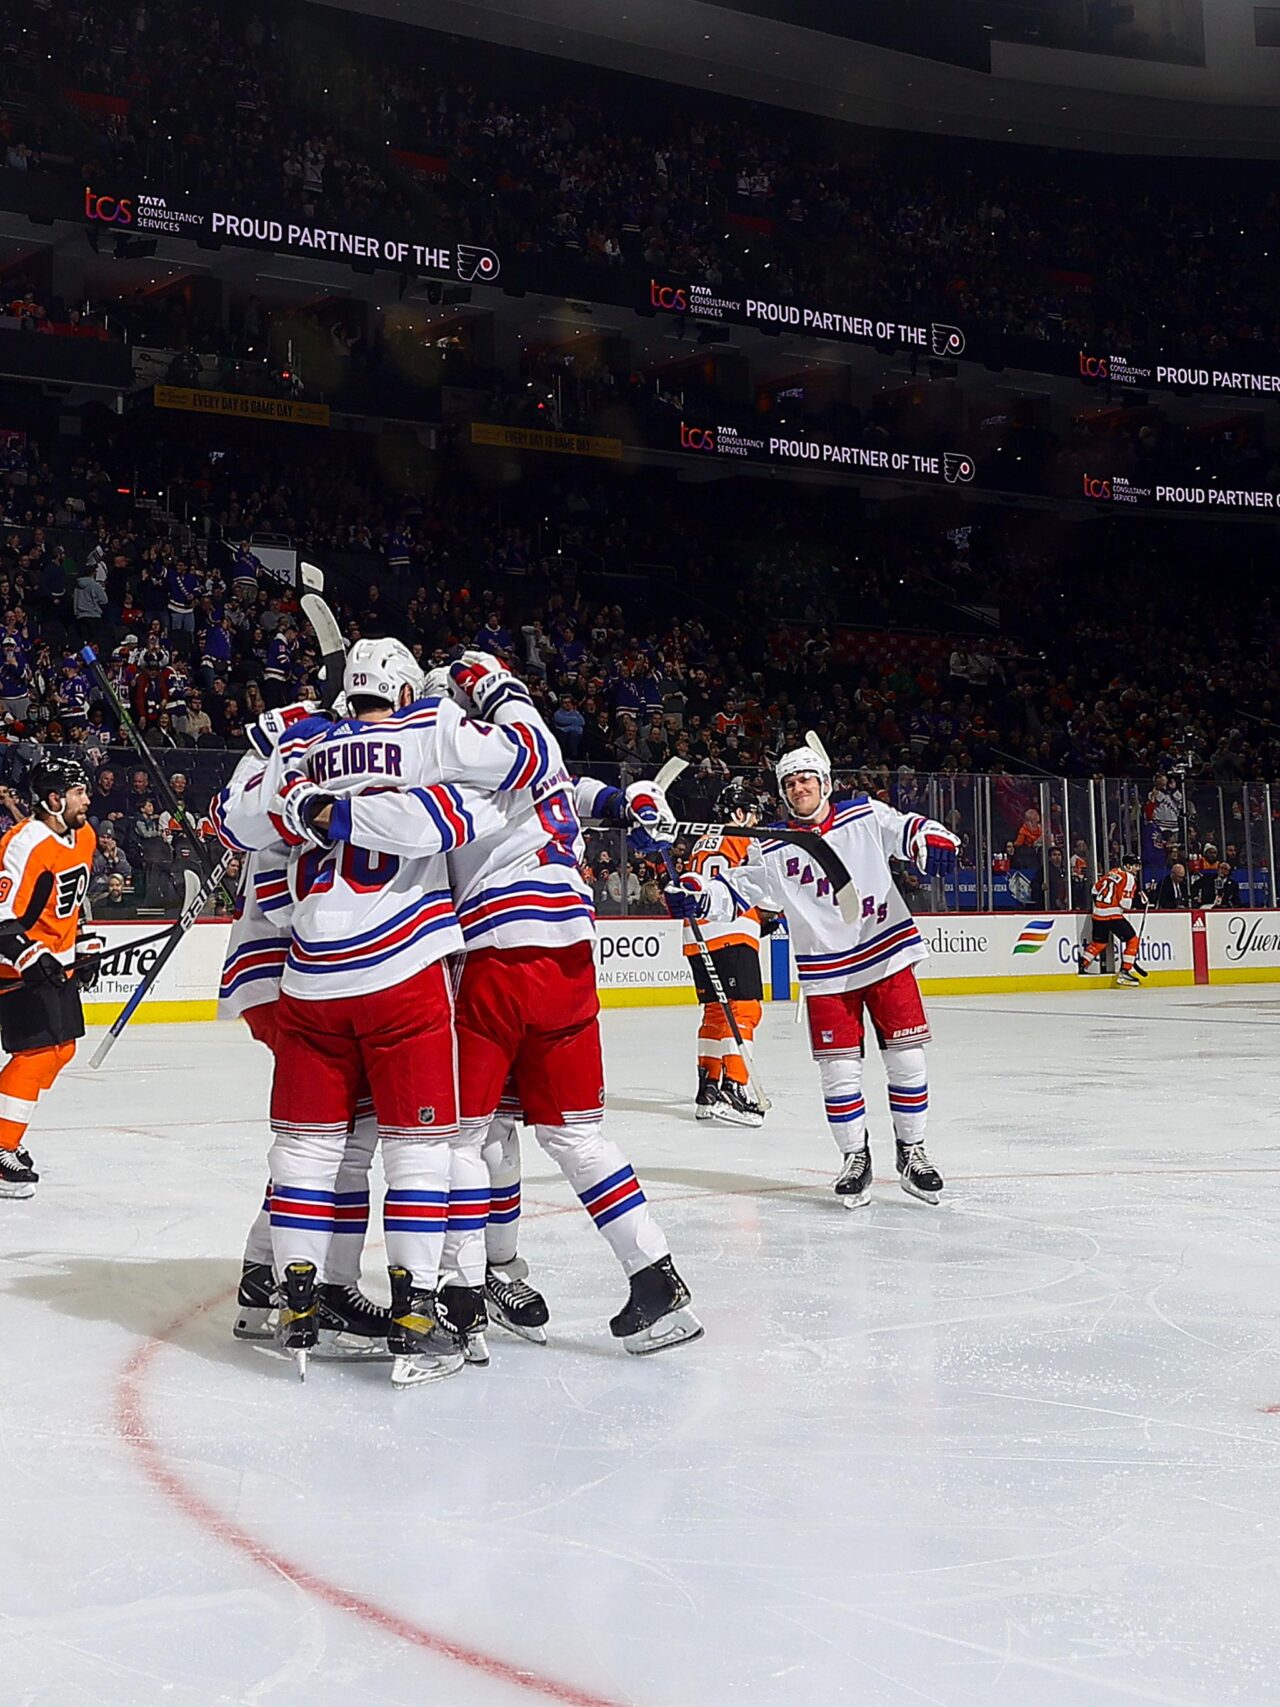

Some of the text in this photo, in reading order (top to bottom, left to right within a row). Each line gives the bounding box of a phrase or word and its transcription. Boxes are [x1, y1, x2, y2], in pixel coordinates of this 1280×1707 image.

[85, 187, 132, 223] tcs
[138, 195, 166, 207] TATA
[137, 206, 204, 225] CONSULTANCY
[137, 218, 180, 232] SERVICES
[212, 212, 450, 270] PROUD PARTNER OF THE
[650, 279, 685, 310] tcs
[690, 285, 711, 295] TATA
[690, 294, 741, 311] CONSULTANCY
[690, 304, 723, 317] SERVICES
[746, 299, 927, 345] PROUD PARTNER OF THE
[1110, 355, 1127, 365] TATA
[1156, 366, 1280, 391] PROUD PARTNER
[193, 393, 218, 410] EVERY
[222, 396, 237, 411] DAY
[241, 399, 248, 413] IS
[251, 400, 274, 416] GAME
[277, 403, 293, 418] DAY
[681, 421, 713, 450] tcs
[717, 426, 737, 436] TATA
[717, 435, 764, 449] CONSULTANCY
[717, 444, 748, 456] SERVICES
[770, 438, 939, 474] PROUD PARTNER OF THE
[1112, 477, 1129, 485] TATA
[1156, 486, 1205, 503] PROUD
[1208, 489, 1273, 507] PARTNER
[353, 673, 367, 686] 20
[658, 821, 724, 836] BAUE
[786, 857, 887, 925] RANRS
[1096, 880, 1114, 904] 21
[600, 935, 660, 965] peco
[96, 948, 158, 978] are
[599, 970, 692, 983] AN EXELON COMPA
[106, 980, 156, 996] Thery
[893, 1024, 928, 1039] BAUER
